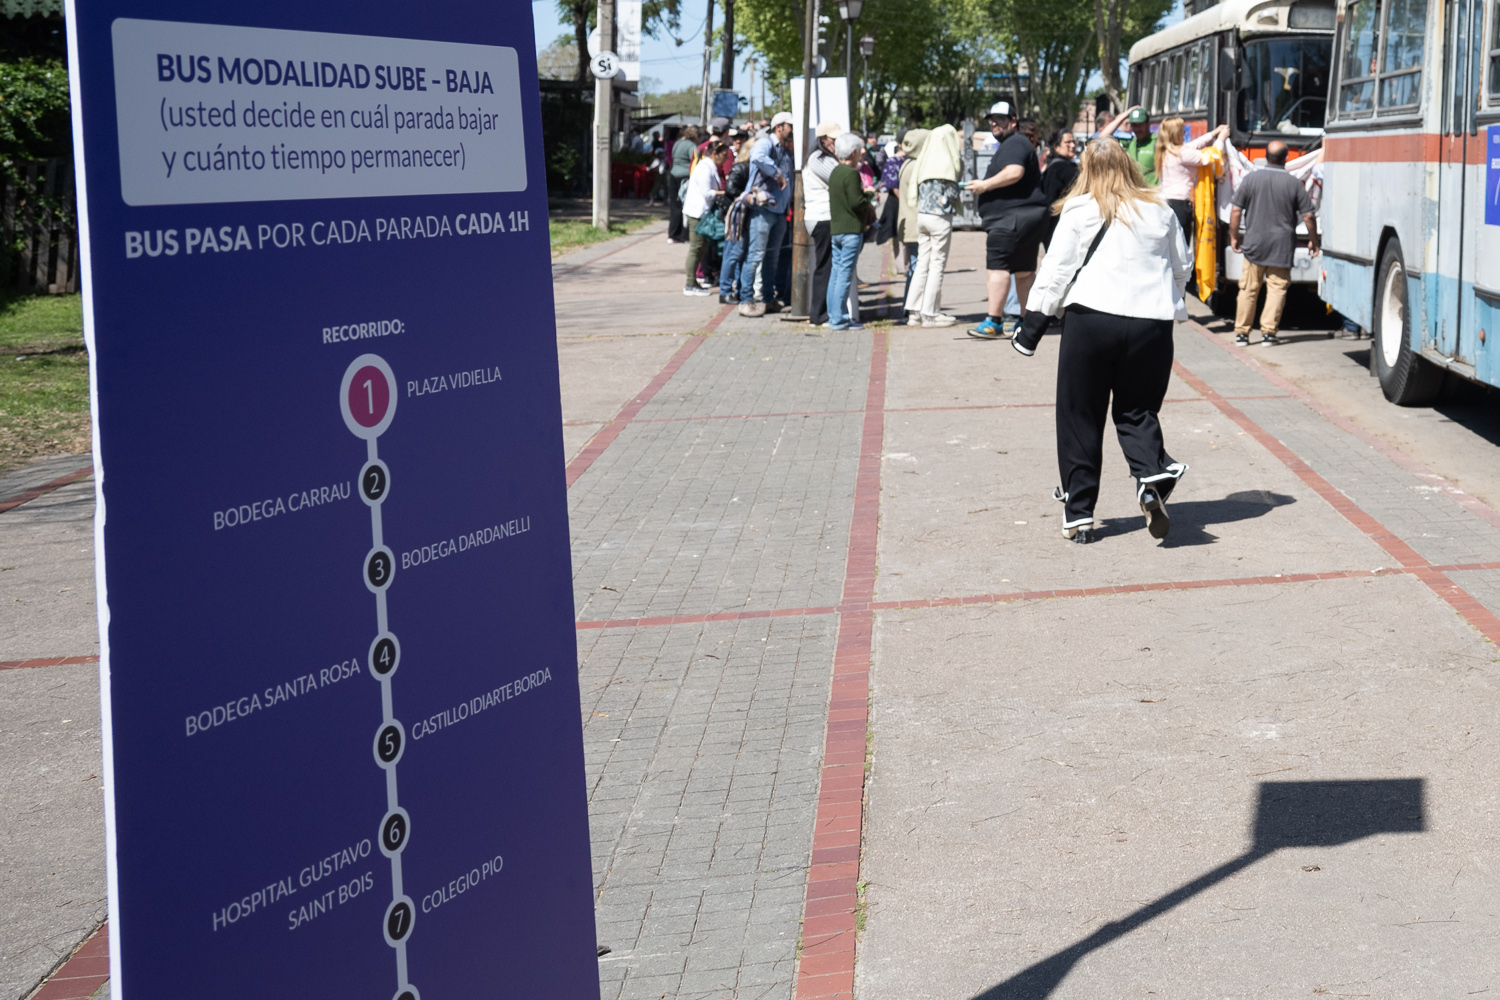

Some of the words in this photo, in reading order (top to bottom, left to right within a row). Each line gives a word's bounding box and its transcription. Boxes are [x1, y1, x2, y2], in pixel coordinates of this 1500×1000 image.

[157, 54, 211, 83] BUS
[218, 57, 370, 89] MODALIDAD
[375, 65, 427, 92] SUBE
[446, 69, 494, 94] BAJA
[161, 97, 236, 131] (usted
[243, 100, 315, 128] decide
[321, 110, 345, 128] en
[350, 104, 389, 129] cuál
[395, 106, 454, 134] parada
[459, 107, 498, 135] bajar
[162, 151, 177, 178] y
[184, 144, 266, 171] cuánto
[271, 143, 346, 174] tiempo
[351, 143, 466, 173] permanecer)
[125, 229, 178, 258] BUS
[186, 226, 252, 254] PASA
[258, 223, 305, 249] POR
[311, 220, 371, 246] CADA
[376, 215, 452, 240] PARADA
[456, 212, 505, 236] CADA
[509, 211, 529, 232] 1H
[322, 319, 405, 344] RECORRIDO:
[363, 380, 374, 414] 1
[407, 376, 448, 397] PLAZA
[450, 367, 501, 391] VIDIELLA
[370, 473, 380, 493] 2
[213, 499, 286, 531] BODEGA
[290, 482, 350, 512] CARRAU
[401, 539, 457, 569] BODEGA
[459, 516, 530, 552] DARDANELLI
[375, 559, 385, 580] 3
[379, 646, 390, 666] 4
[185, 694, 262, 736] BODEGA
[264, 675, 317, 709] SANTA
[320, 658, 361, 689] ROSA
[412, 704, 468, 740] CASTILLO
[470, 684, 512, 717] IDIARTE
[513, 668, 552, 698] BORDA
[385, 734, 395, 755] 5
[390, 821, 400, 842] 6
[213, 878, 297, 931] HOSPITAL
[300, 840, 372, 891] GUSTAVO
[288, 889, 334, 930] SAINT
[337, 871, 374, 906] BOIS
[422, 873, 473, 913] COLEGIO
[480, 855, 503, 882] PIO
[394, 910, 405, 932] 7
